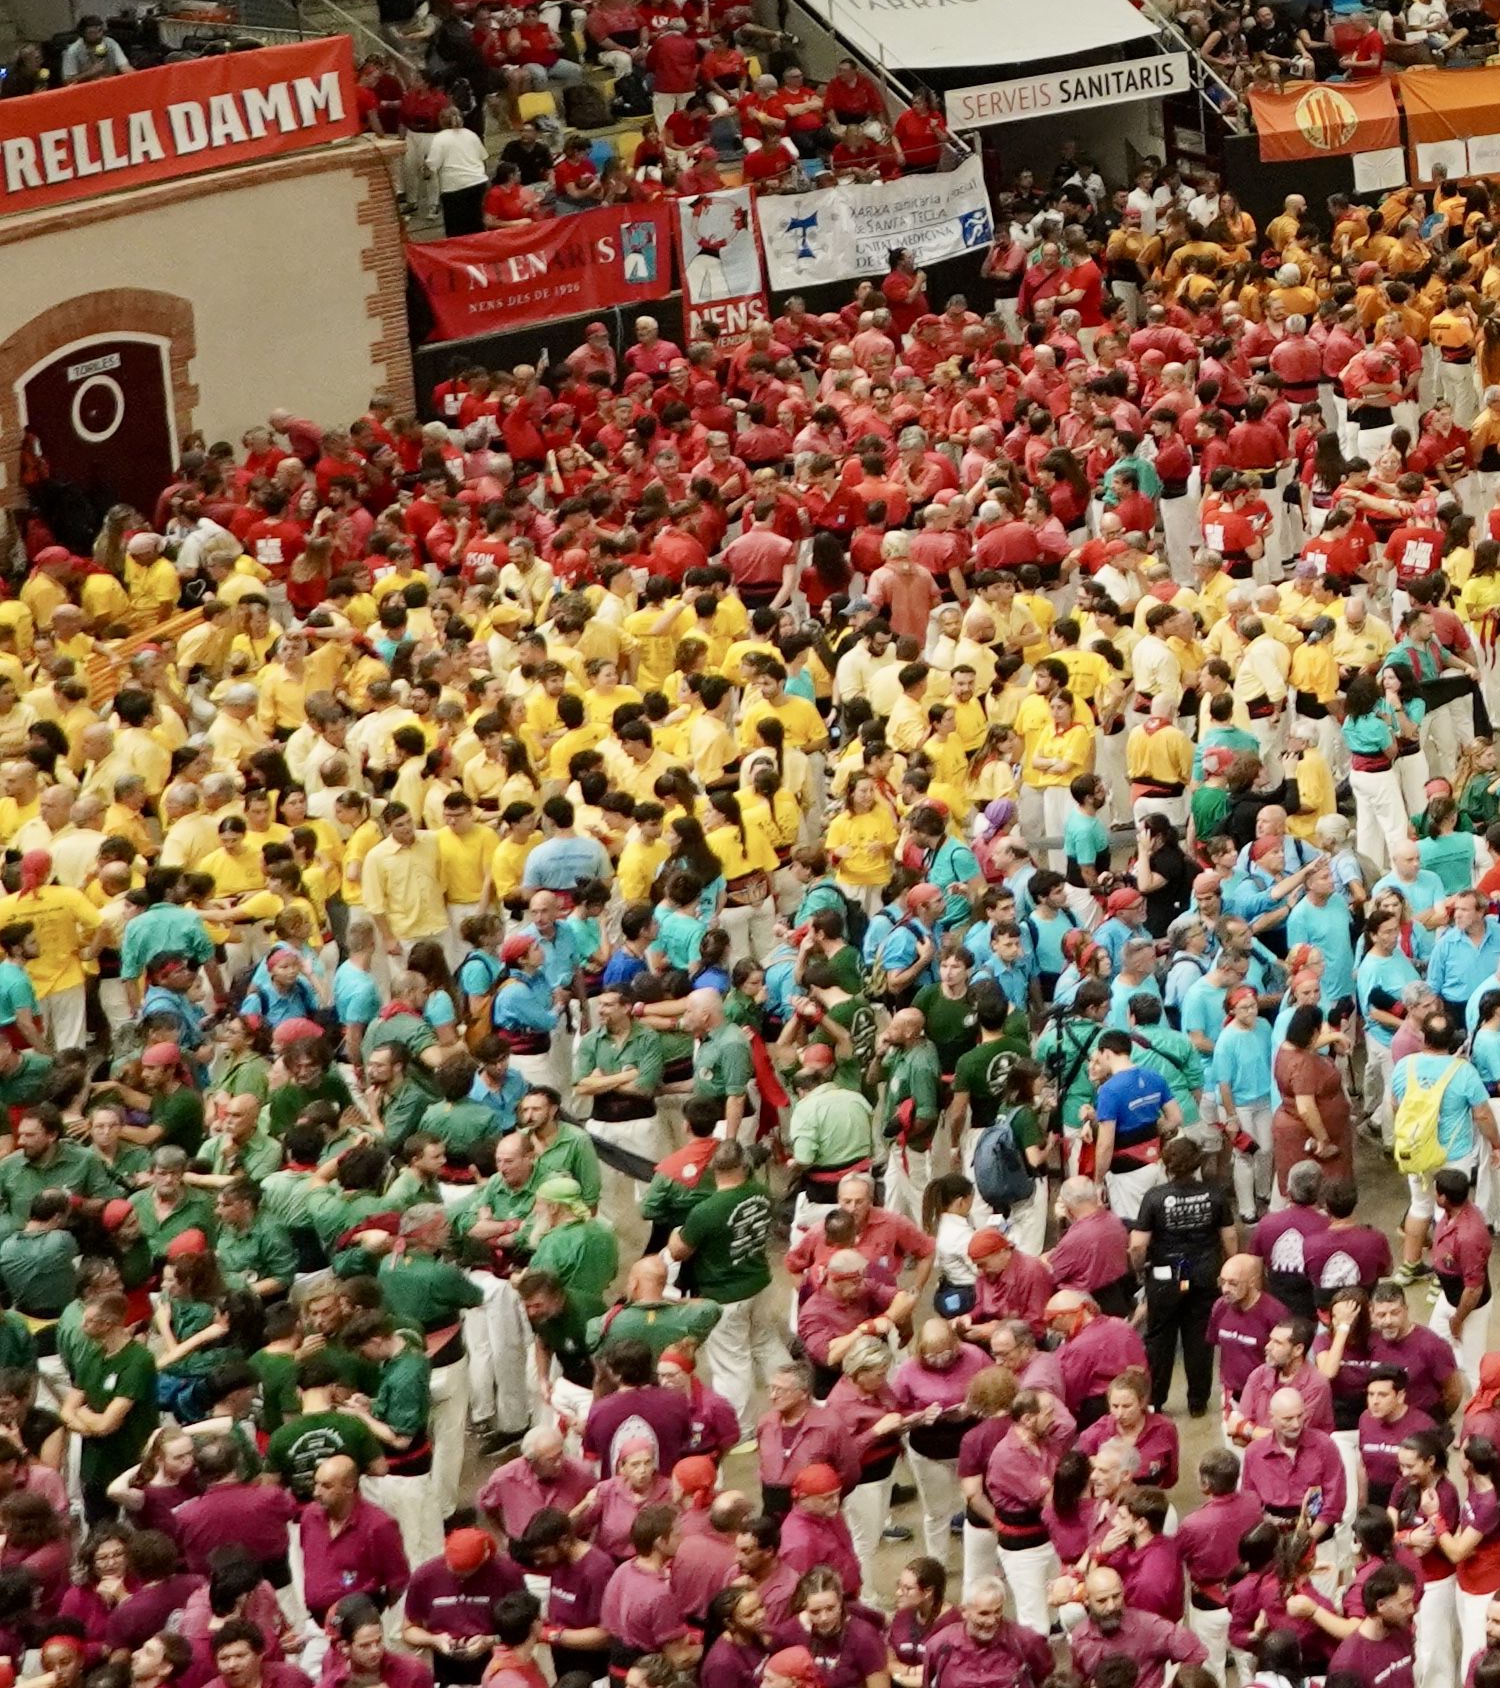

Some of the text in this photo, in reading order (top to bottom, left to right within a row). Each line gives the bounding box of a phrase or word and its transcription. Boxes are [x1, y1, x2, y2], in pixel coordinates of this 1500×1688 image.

[168, 71, 347, 156] DAMM
[962, 62, 1175, 121] SERVEIS SANITARIS
[468, 299, 504, 315] NENS
[534, 289, 552, 302] DE
[689, 298, 765, 341] NENS
